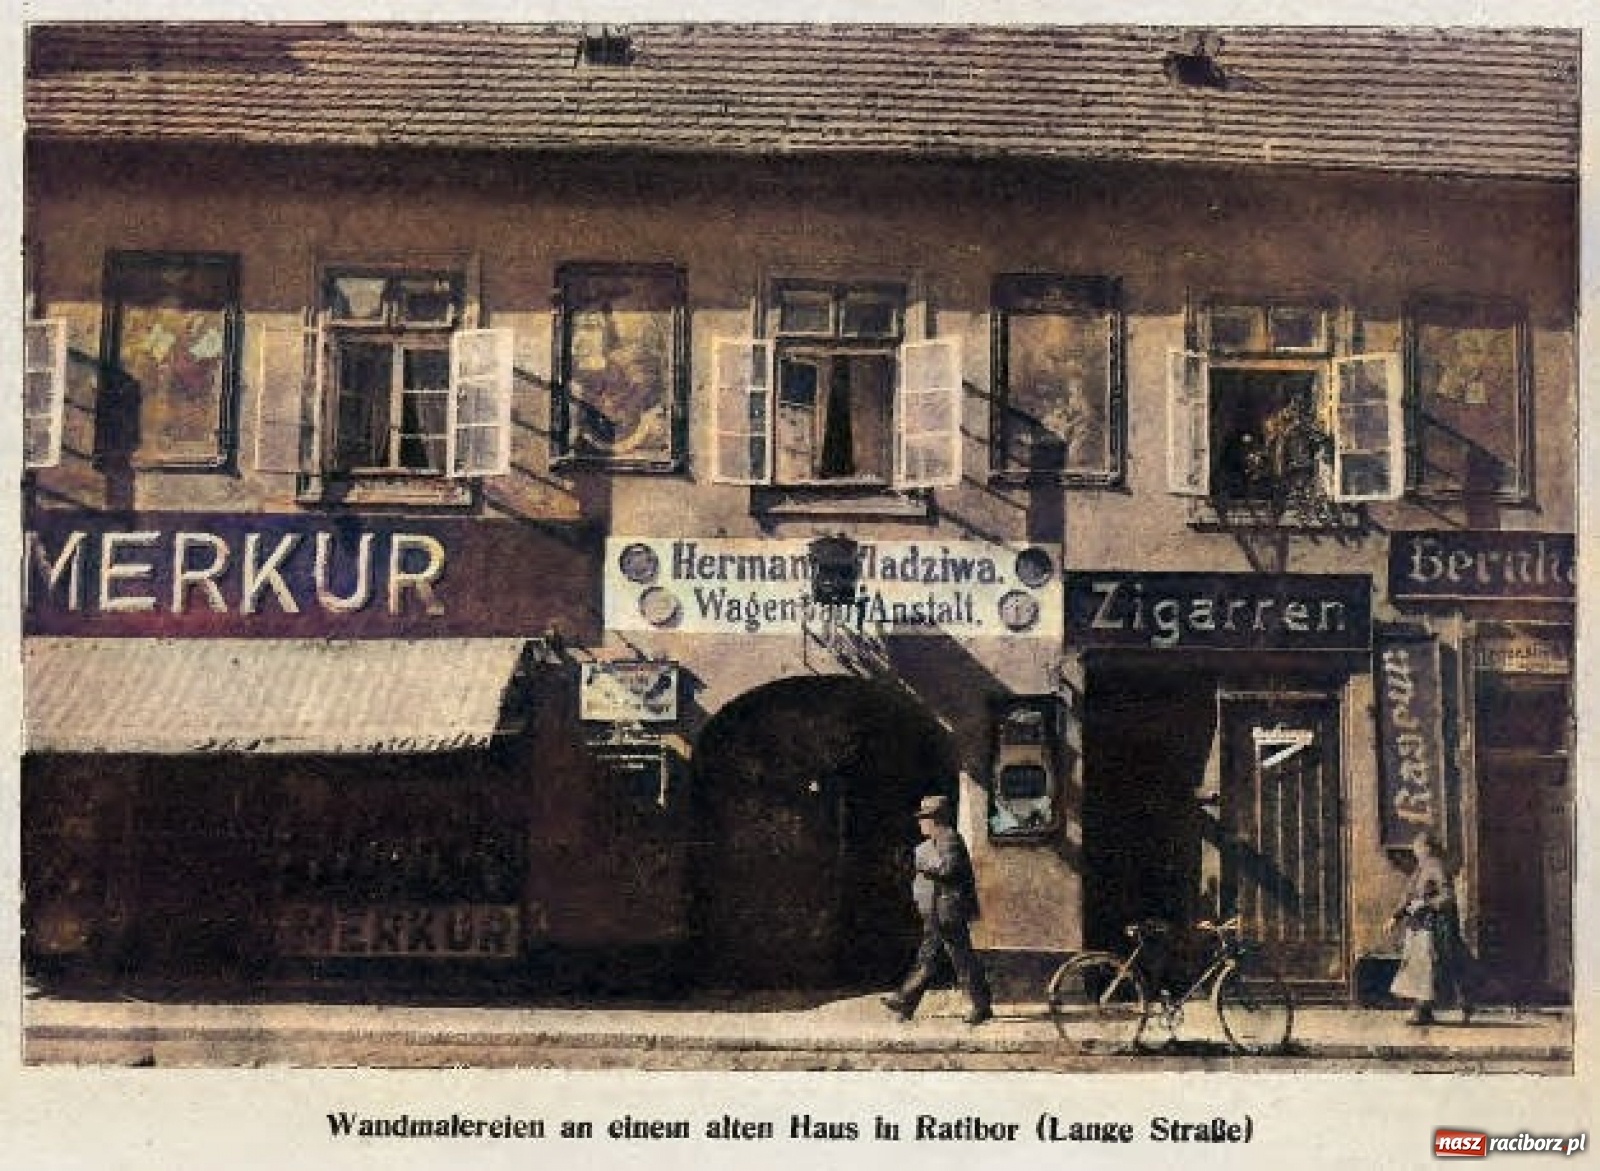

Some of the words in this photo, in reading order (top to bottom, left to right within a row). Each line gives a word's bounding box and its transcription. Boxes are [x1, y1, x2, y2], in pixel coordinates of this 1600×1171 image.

[24, 531, 446, 615] MERKUR
[673, 542, 818, 580] Herman
[856, 545, 1003, 583] ladziwa.
[1091, 581, 1346, 647] Zigarren
